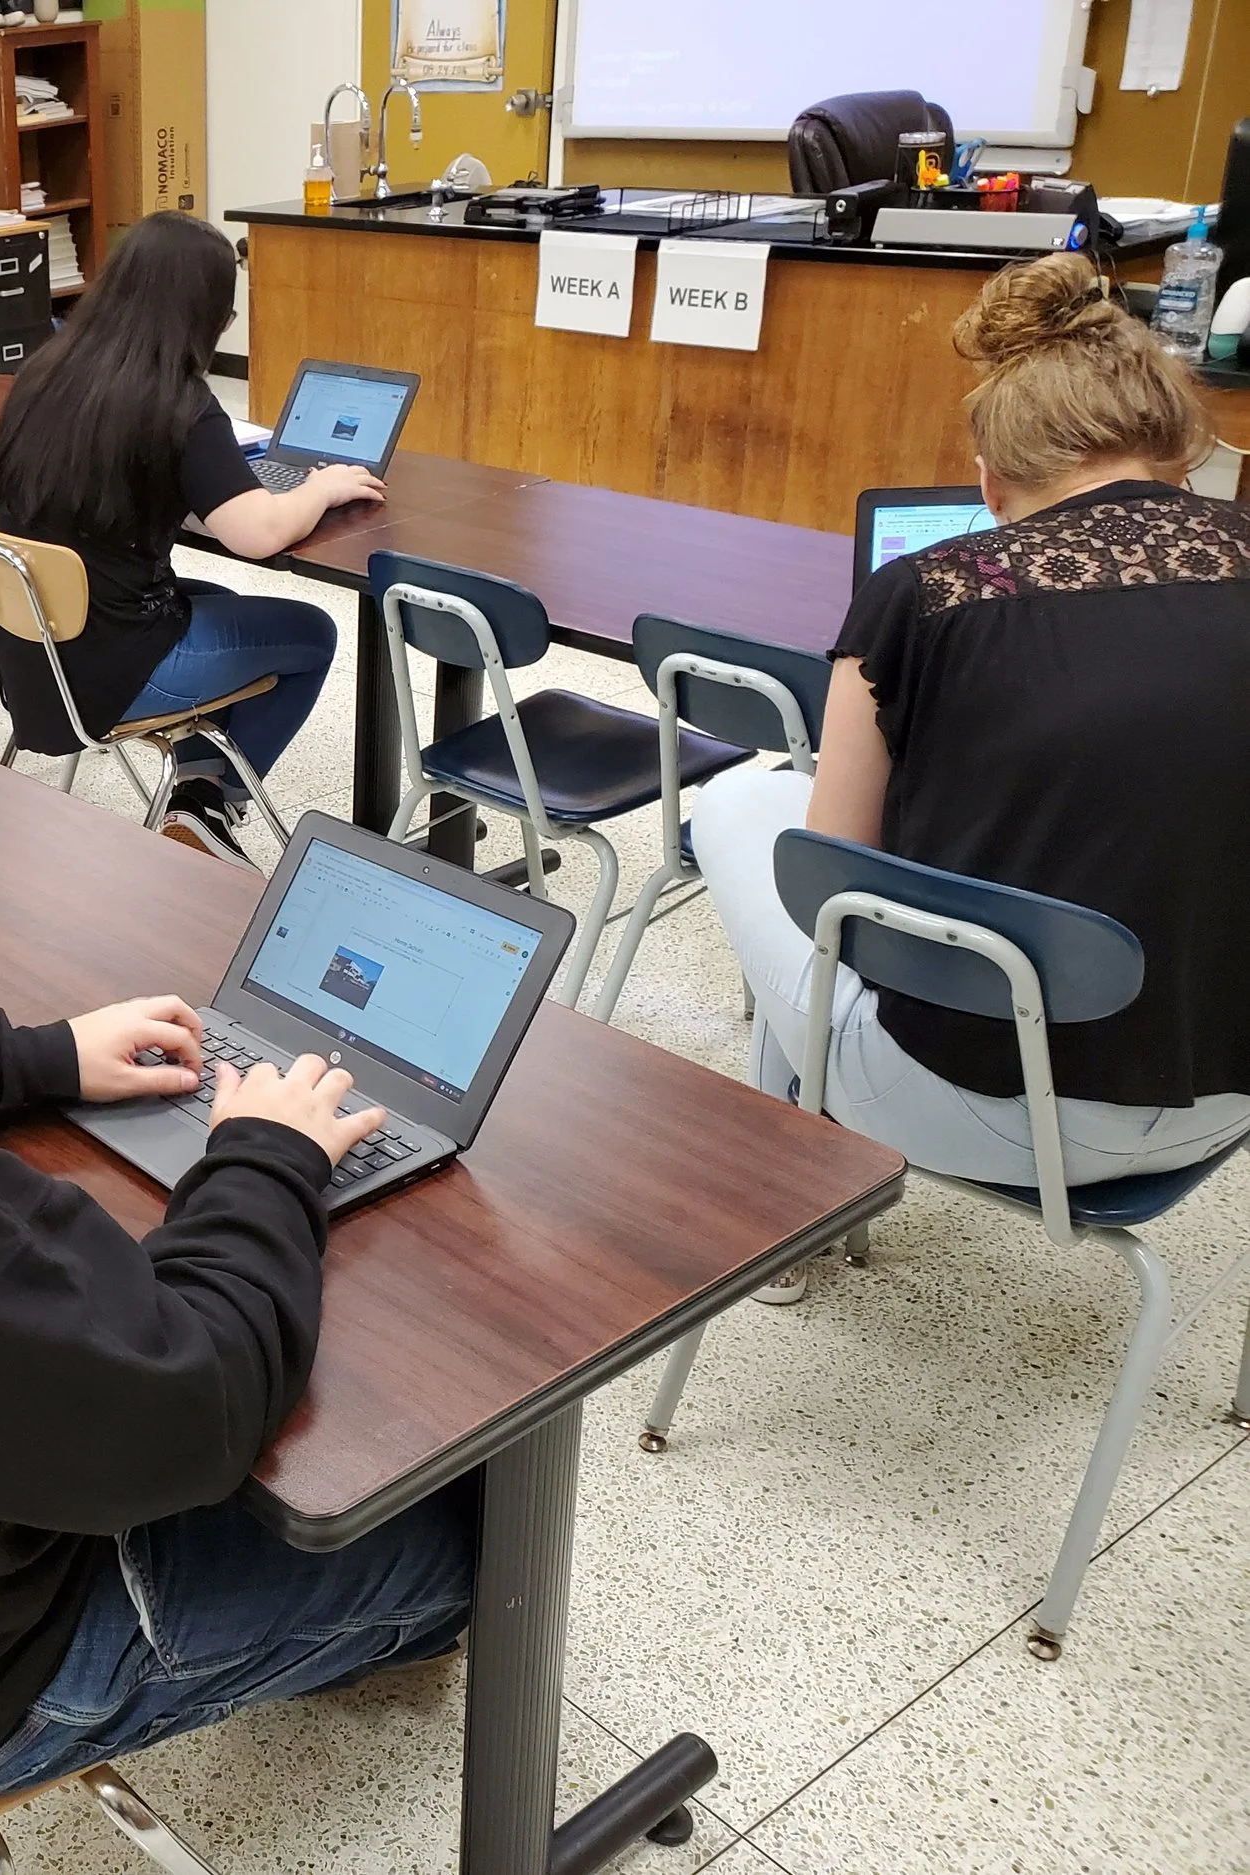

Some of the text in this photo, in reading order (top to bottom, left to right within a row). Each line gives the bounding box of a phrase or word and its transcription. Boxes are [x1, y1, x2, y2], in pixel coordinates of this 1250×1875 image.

[157, 128, 168, 195] NOMACO
[550, 274, 621, 300] WEEK A
[669, 286, 749, 311] WEEK B
